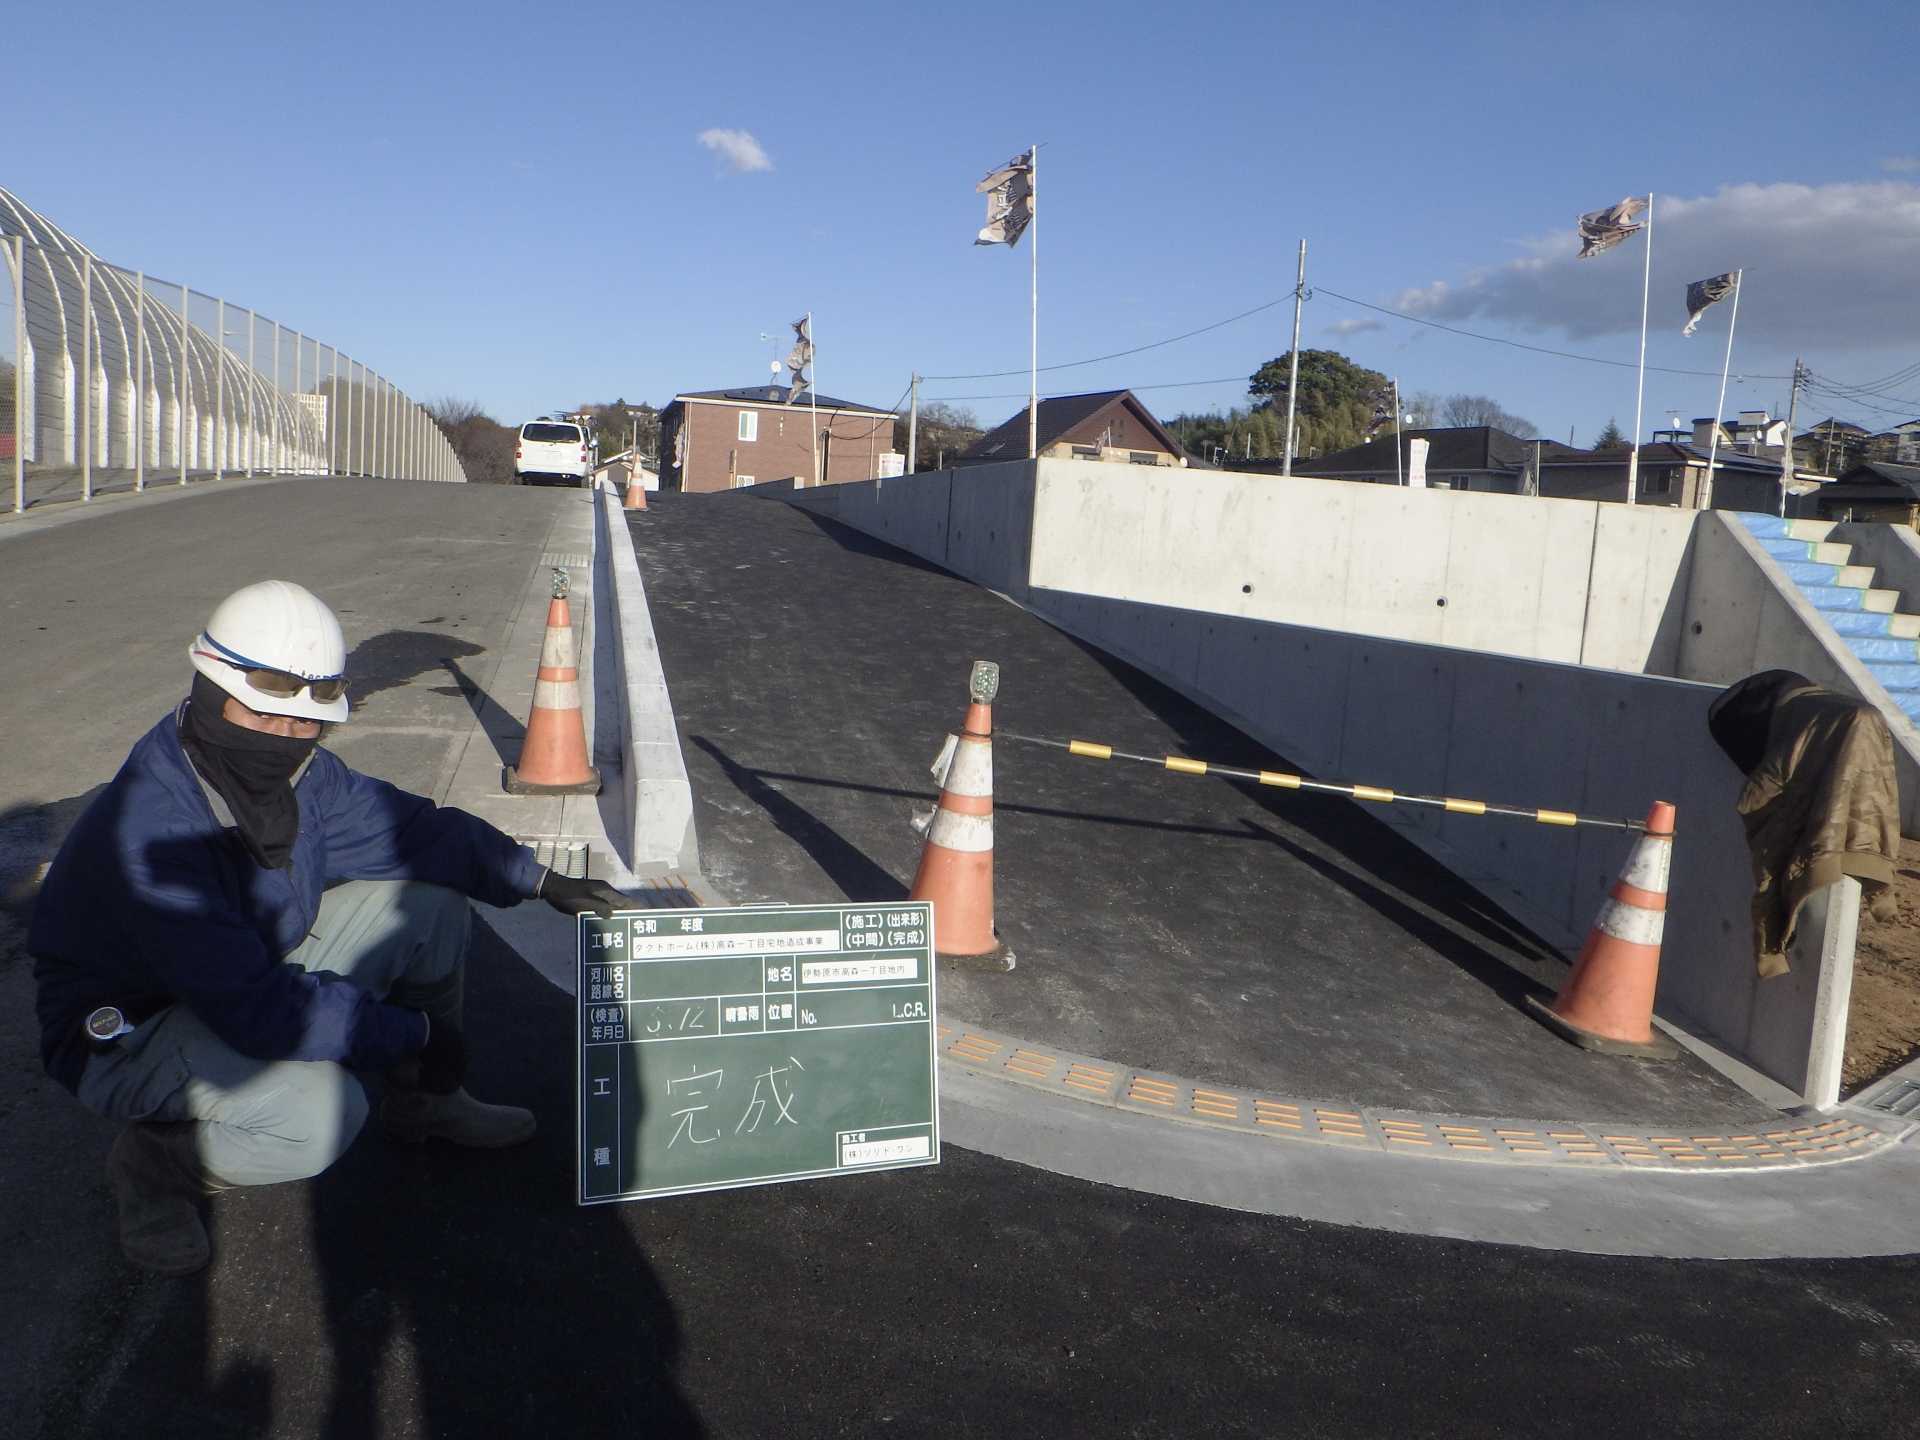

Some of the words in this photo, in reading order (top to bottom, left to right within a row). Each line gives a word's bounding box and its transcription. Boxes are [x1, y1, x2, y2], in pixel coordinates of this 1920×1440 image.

[633, 919, 657, 934] 令和
[680, 918, 704, 932] 年度
[845, 914, 884, 930] (施工)
[887, 912, 924, 928] (出来形)
[591, 932, 624, 949] 工事名
[846, 932, 884, 948] (中間)
[887, 930, 925, 946] (完成)
[590, 966, 624, 983] 河川名
[767, 966, 793, 983] 地名
[590, 983, 624, 1001] 路線名
[590, 1007, 624, 1024] (検査)
[768, 1003, 793, 1021] 位置
[801, 1008, 818, 1025] No.
[591, 1025, 624, 1041] 年月日
[666, 1055, 806, 1150] 完成
